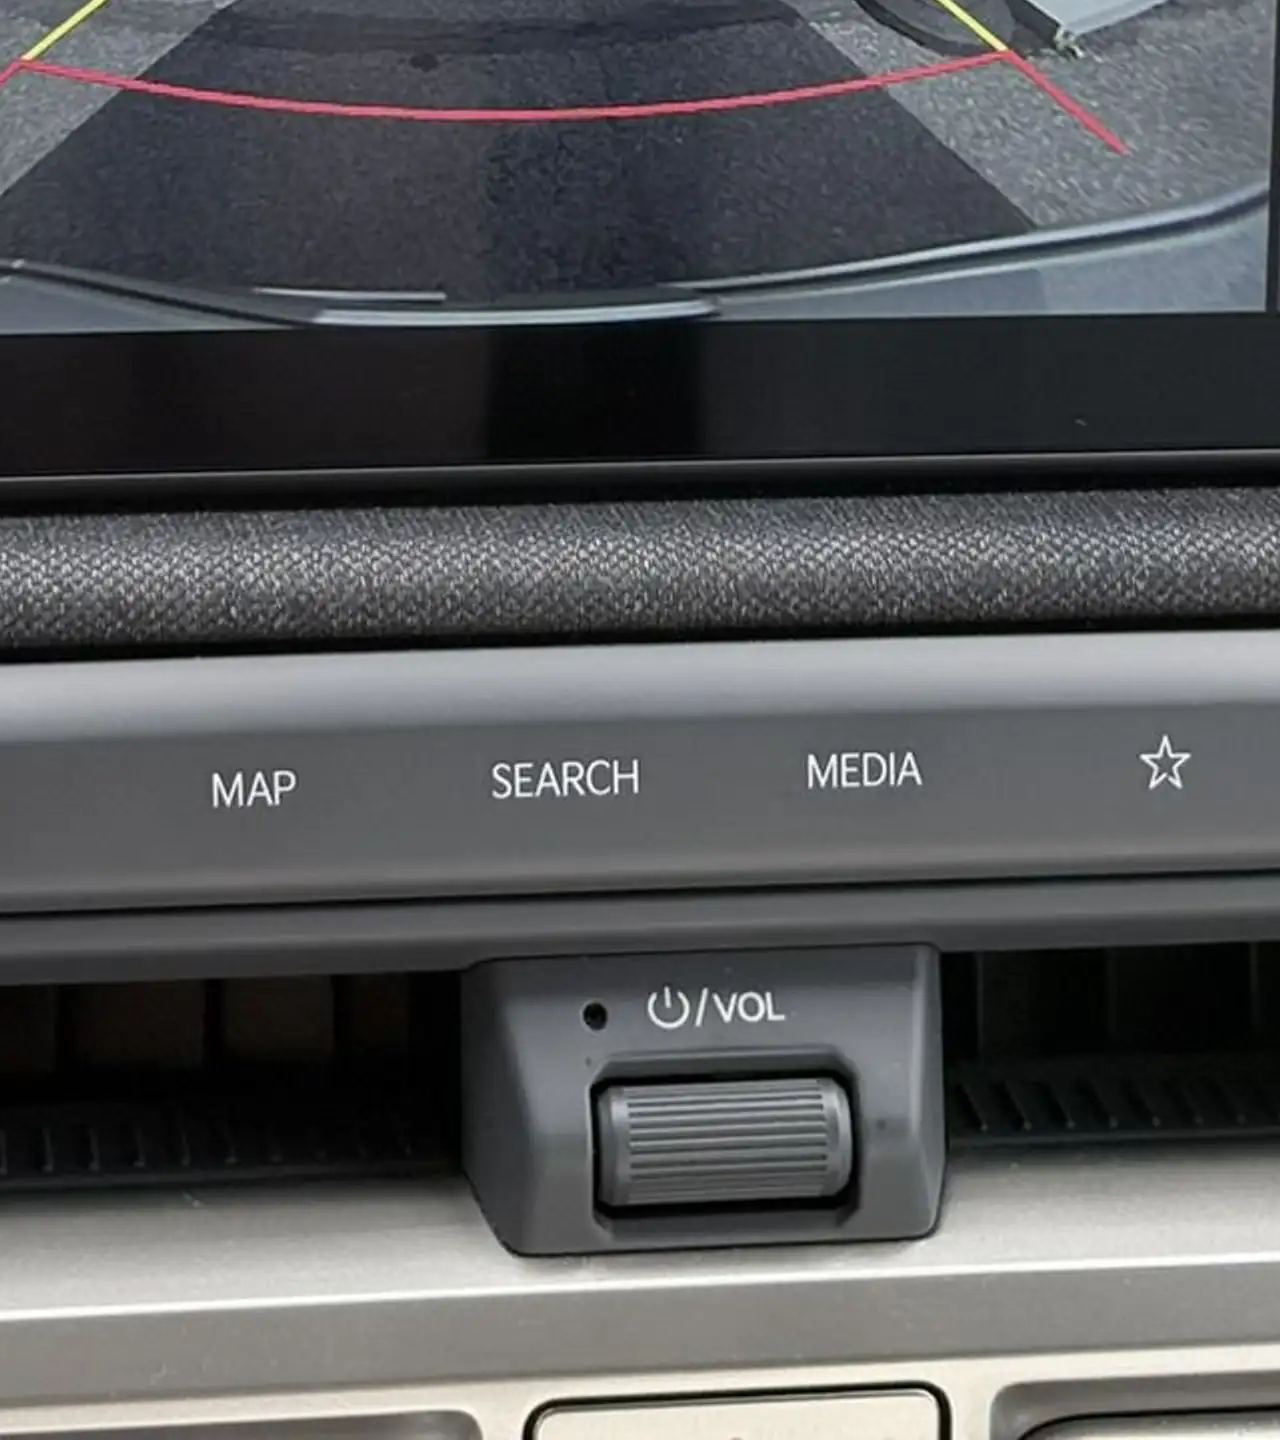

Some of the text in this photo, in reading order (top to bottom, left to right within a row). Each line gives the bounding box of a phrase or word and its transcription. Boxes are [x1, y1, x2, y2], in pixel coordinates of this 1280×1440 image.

[211, 769, 298, 809] MAP
[490, 758, 640, 800] SEARCH
[806, 752, 923, 790] MEDIA
